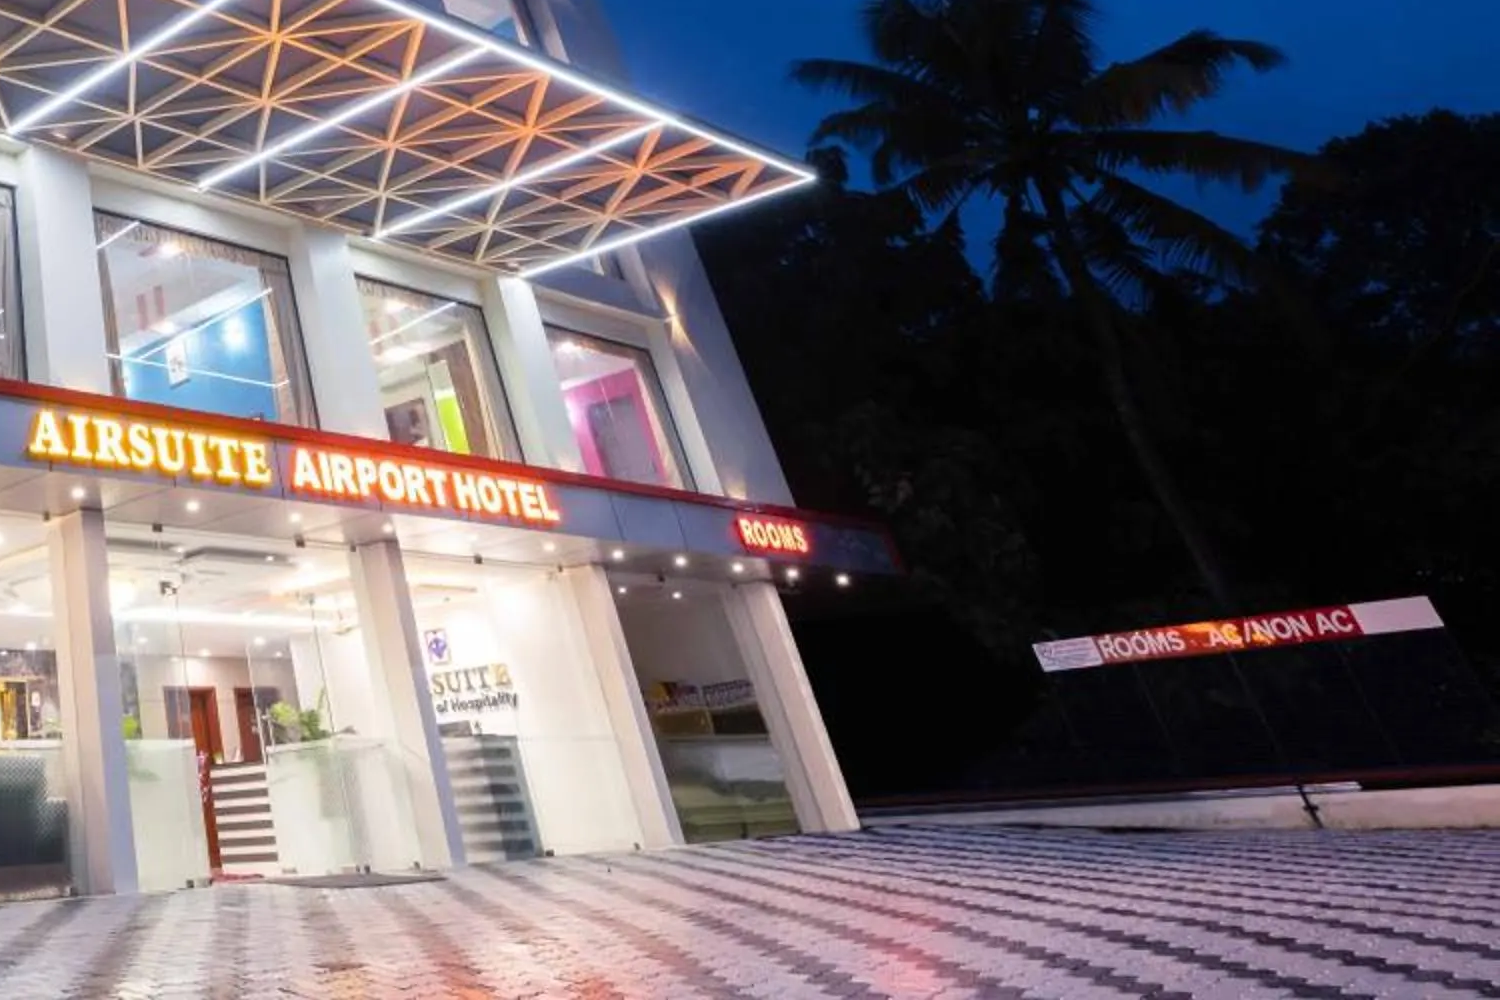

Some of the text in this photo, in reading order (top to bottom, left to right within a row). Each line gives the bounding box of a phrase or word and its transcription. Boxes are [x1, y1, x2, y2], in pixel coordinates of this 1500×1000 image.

[29, 408, 561, 522] AIRSUITE AIRPORT HOTEL
[738, 517, 809, 553] ROOMS
[1098, 631, 1186, 659] ROOMS
[1315, 609, 1353, 635] AC
